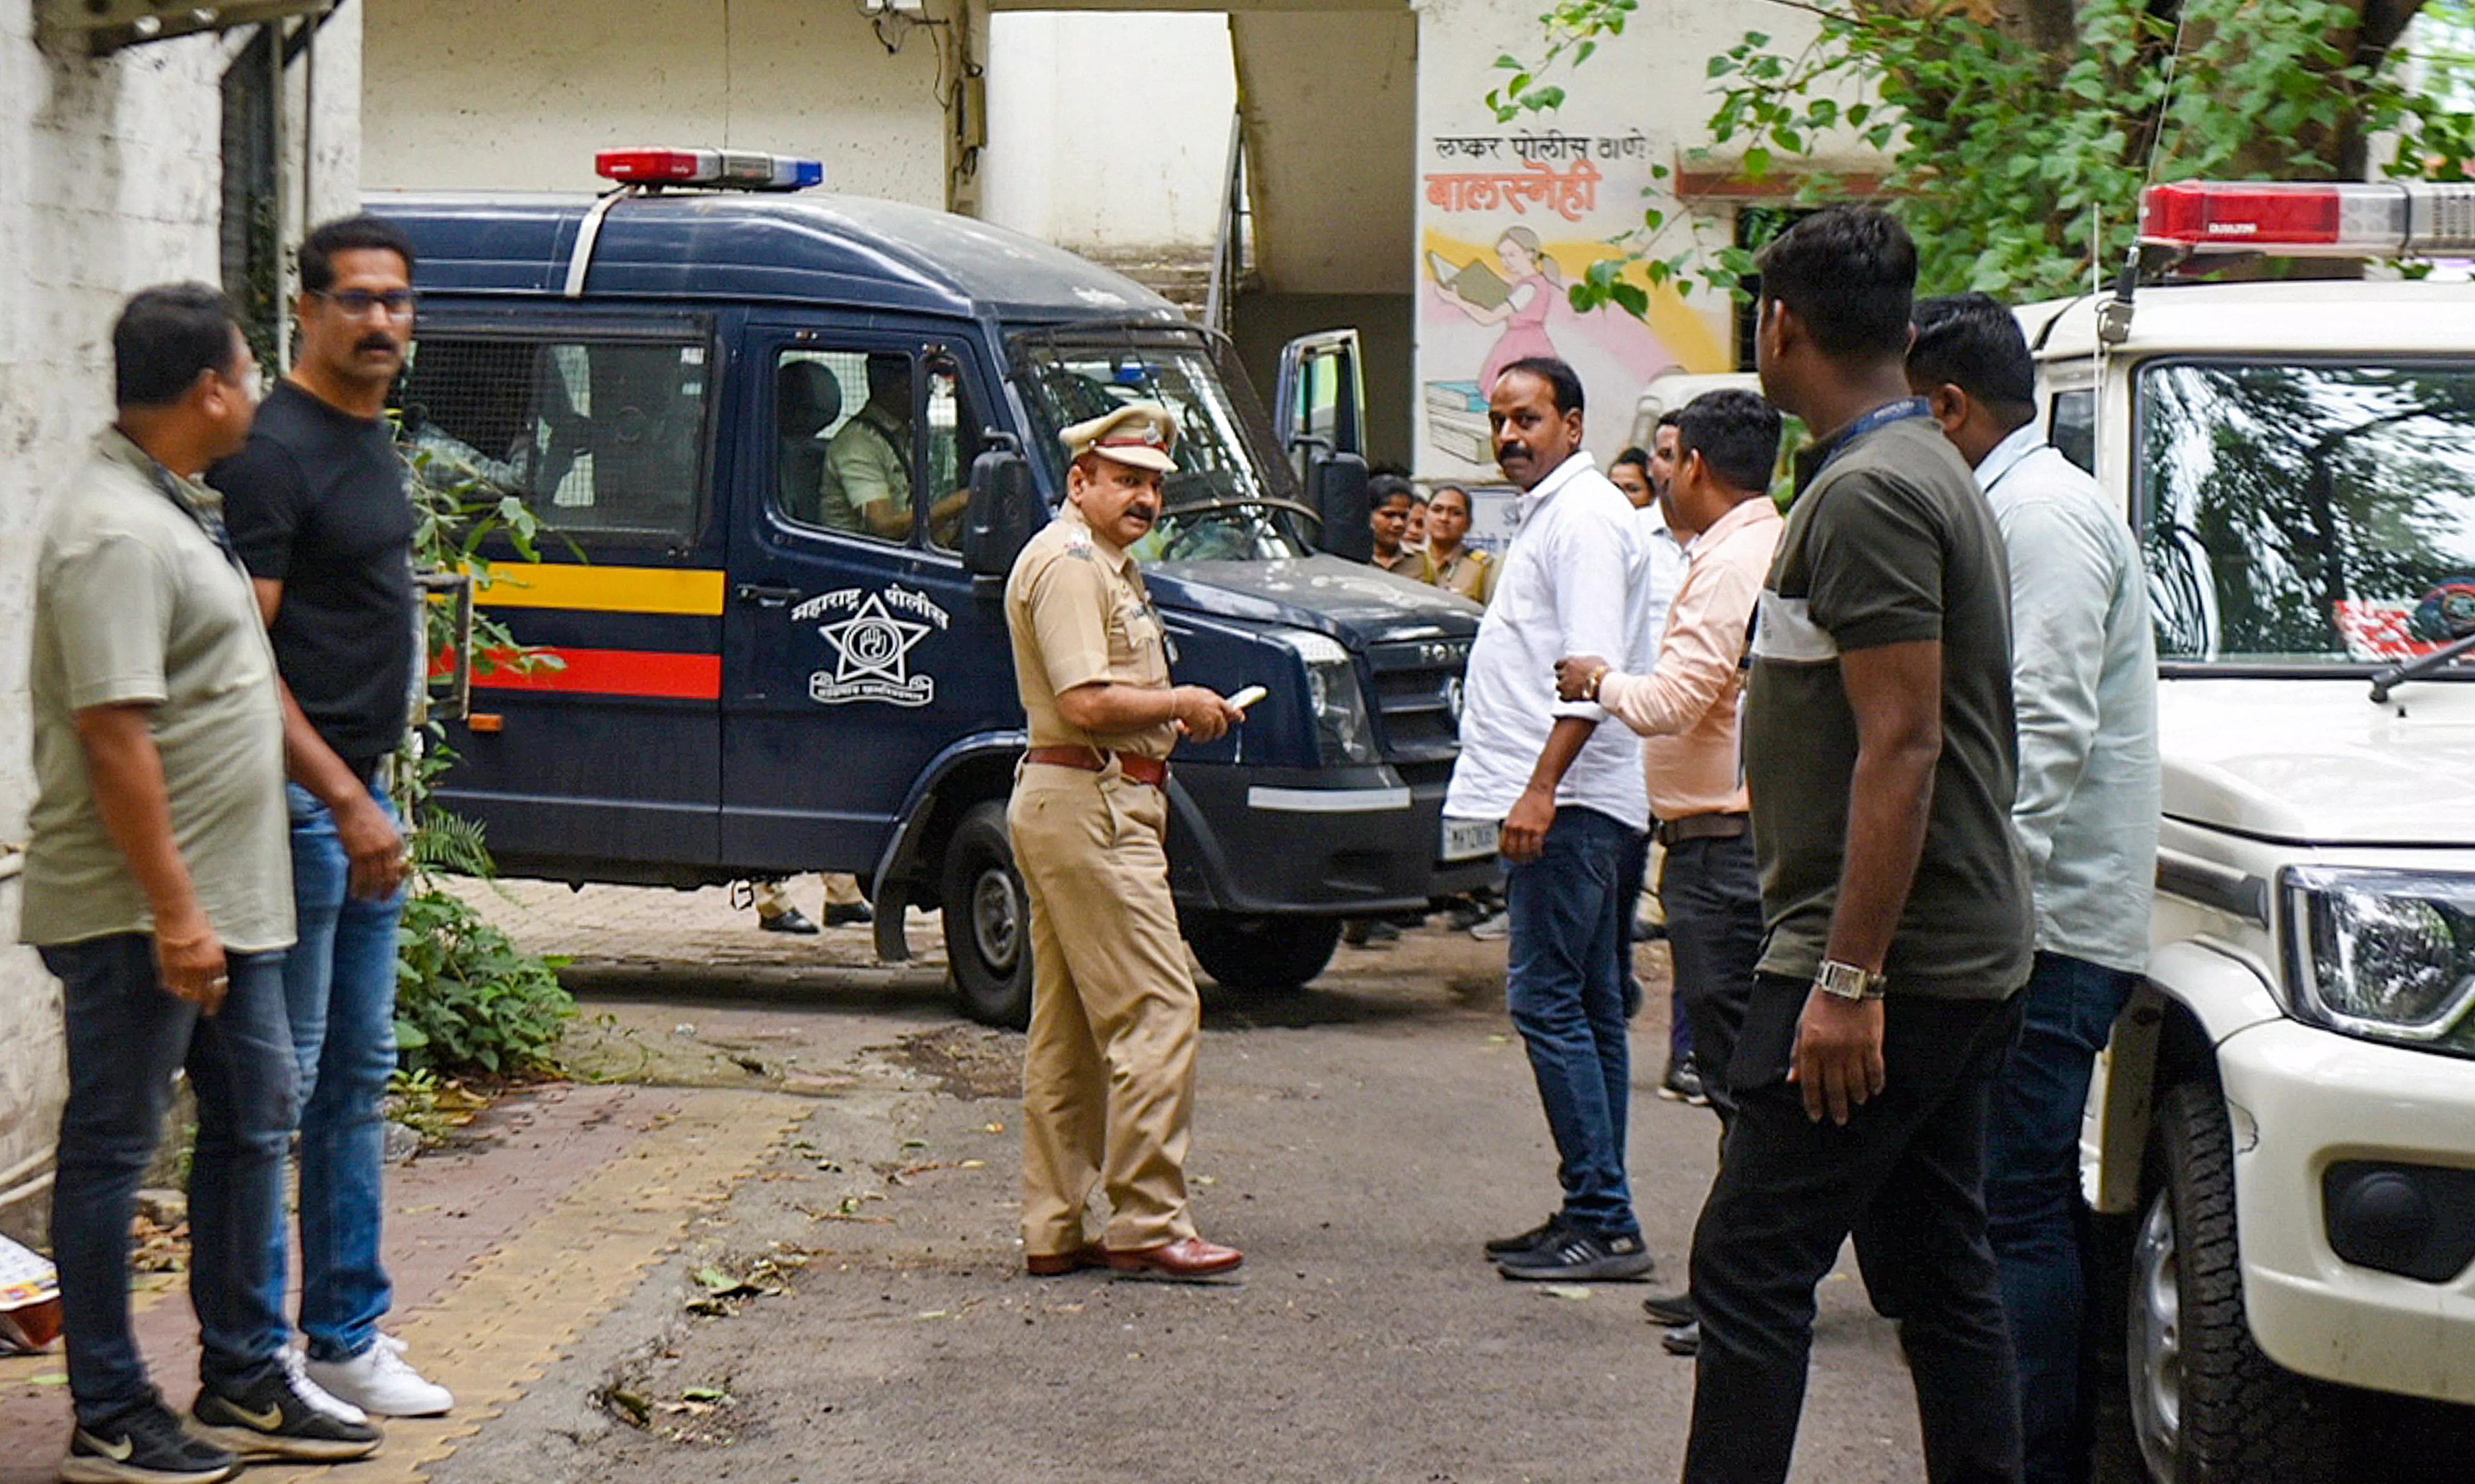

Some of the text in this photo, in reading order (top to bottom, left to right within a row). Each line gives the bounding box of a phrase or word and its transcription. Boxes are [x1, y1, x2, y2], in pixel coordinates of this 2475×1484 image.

[1434, 128, 1647, 161] लष्कर पोलीस ठाणे
[1424, 159, 1603, 222] बालस्नेही
[790, 582, 950, 630] महाराष्ट्र पोलीस
